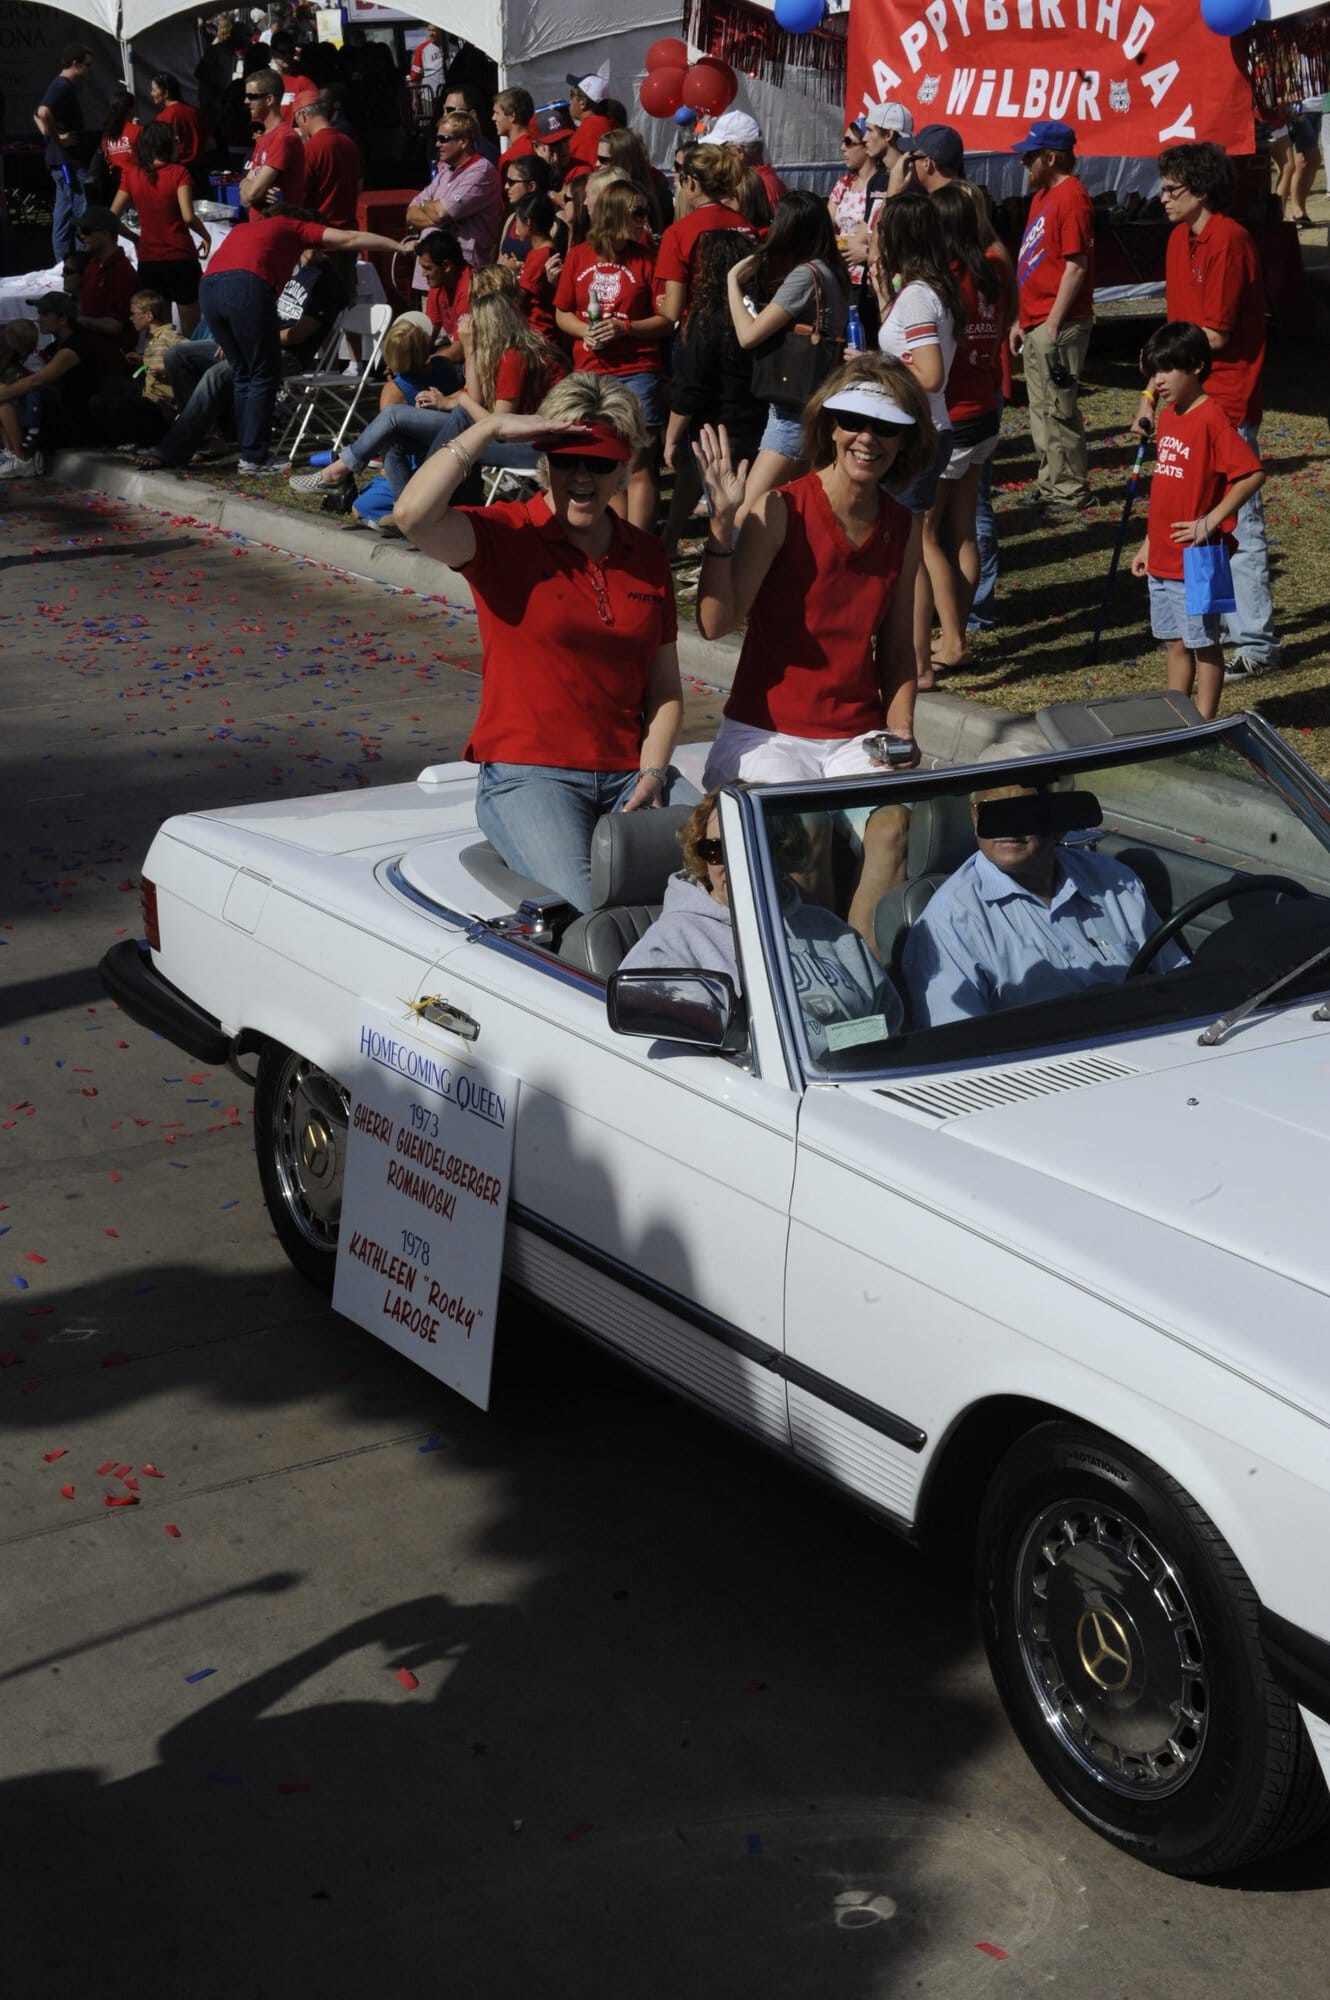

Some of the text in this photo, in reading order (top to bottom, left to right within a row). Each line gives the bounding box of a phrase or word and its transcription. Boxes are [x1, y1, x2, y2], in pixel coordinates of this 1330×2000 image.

[360, 1025, 507, 1123] HOMECOMING QUEEN
[410, 1103, 439, 1138] 1973
[353, 1103, 501, 1206] SHERRI GUENDELSBERGER
[386, 1159, 457, 1222] ROMANOSKI
[349, 1231, 417, 1293] KATHLEEN
[401, 1229, 430, 1266] 1978
[383, 1289, 440, 1344] LAROSE
